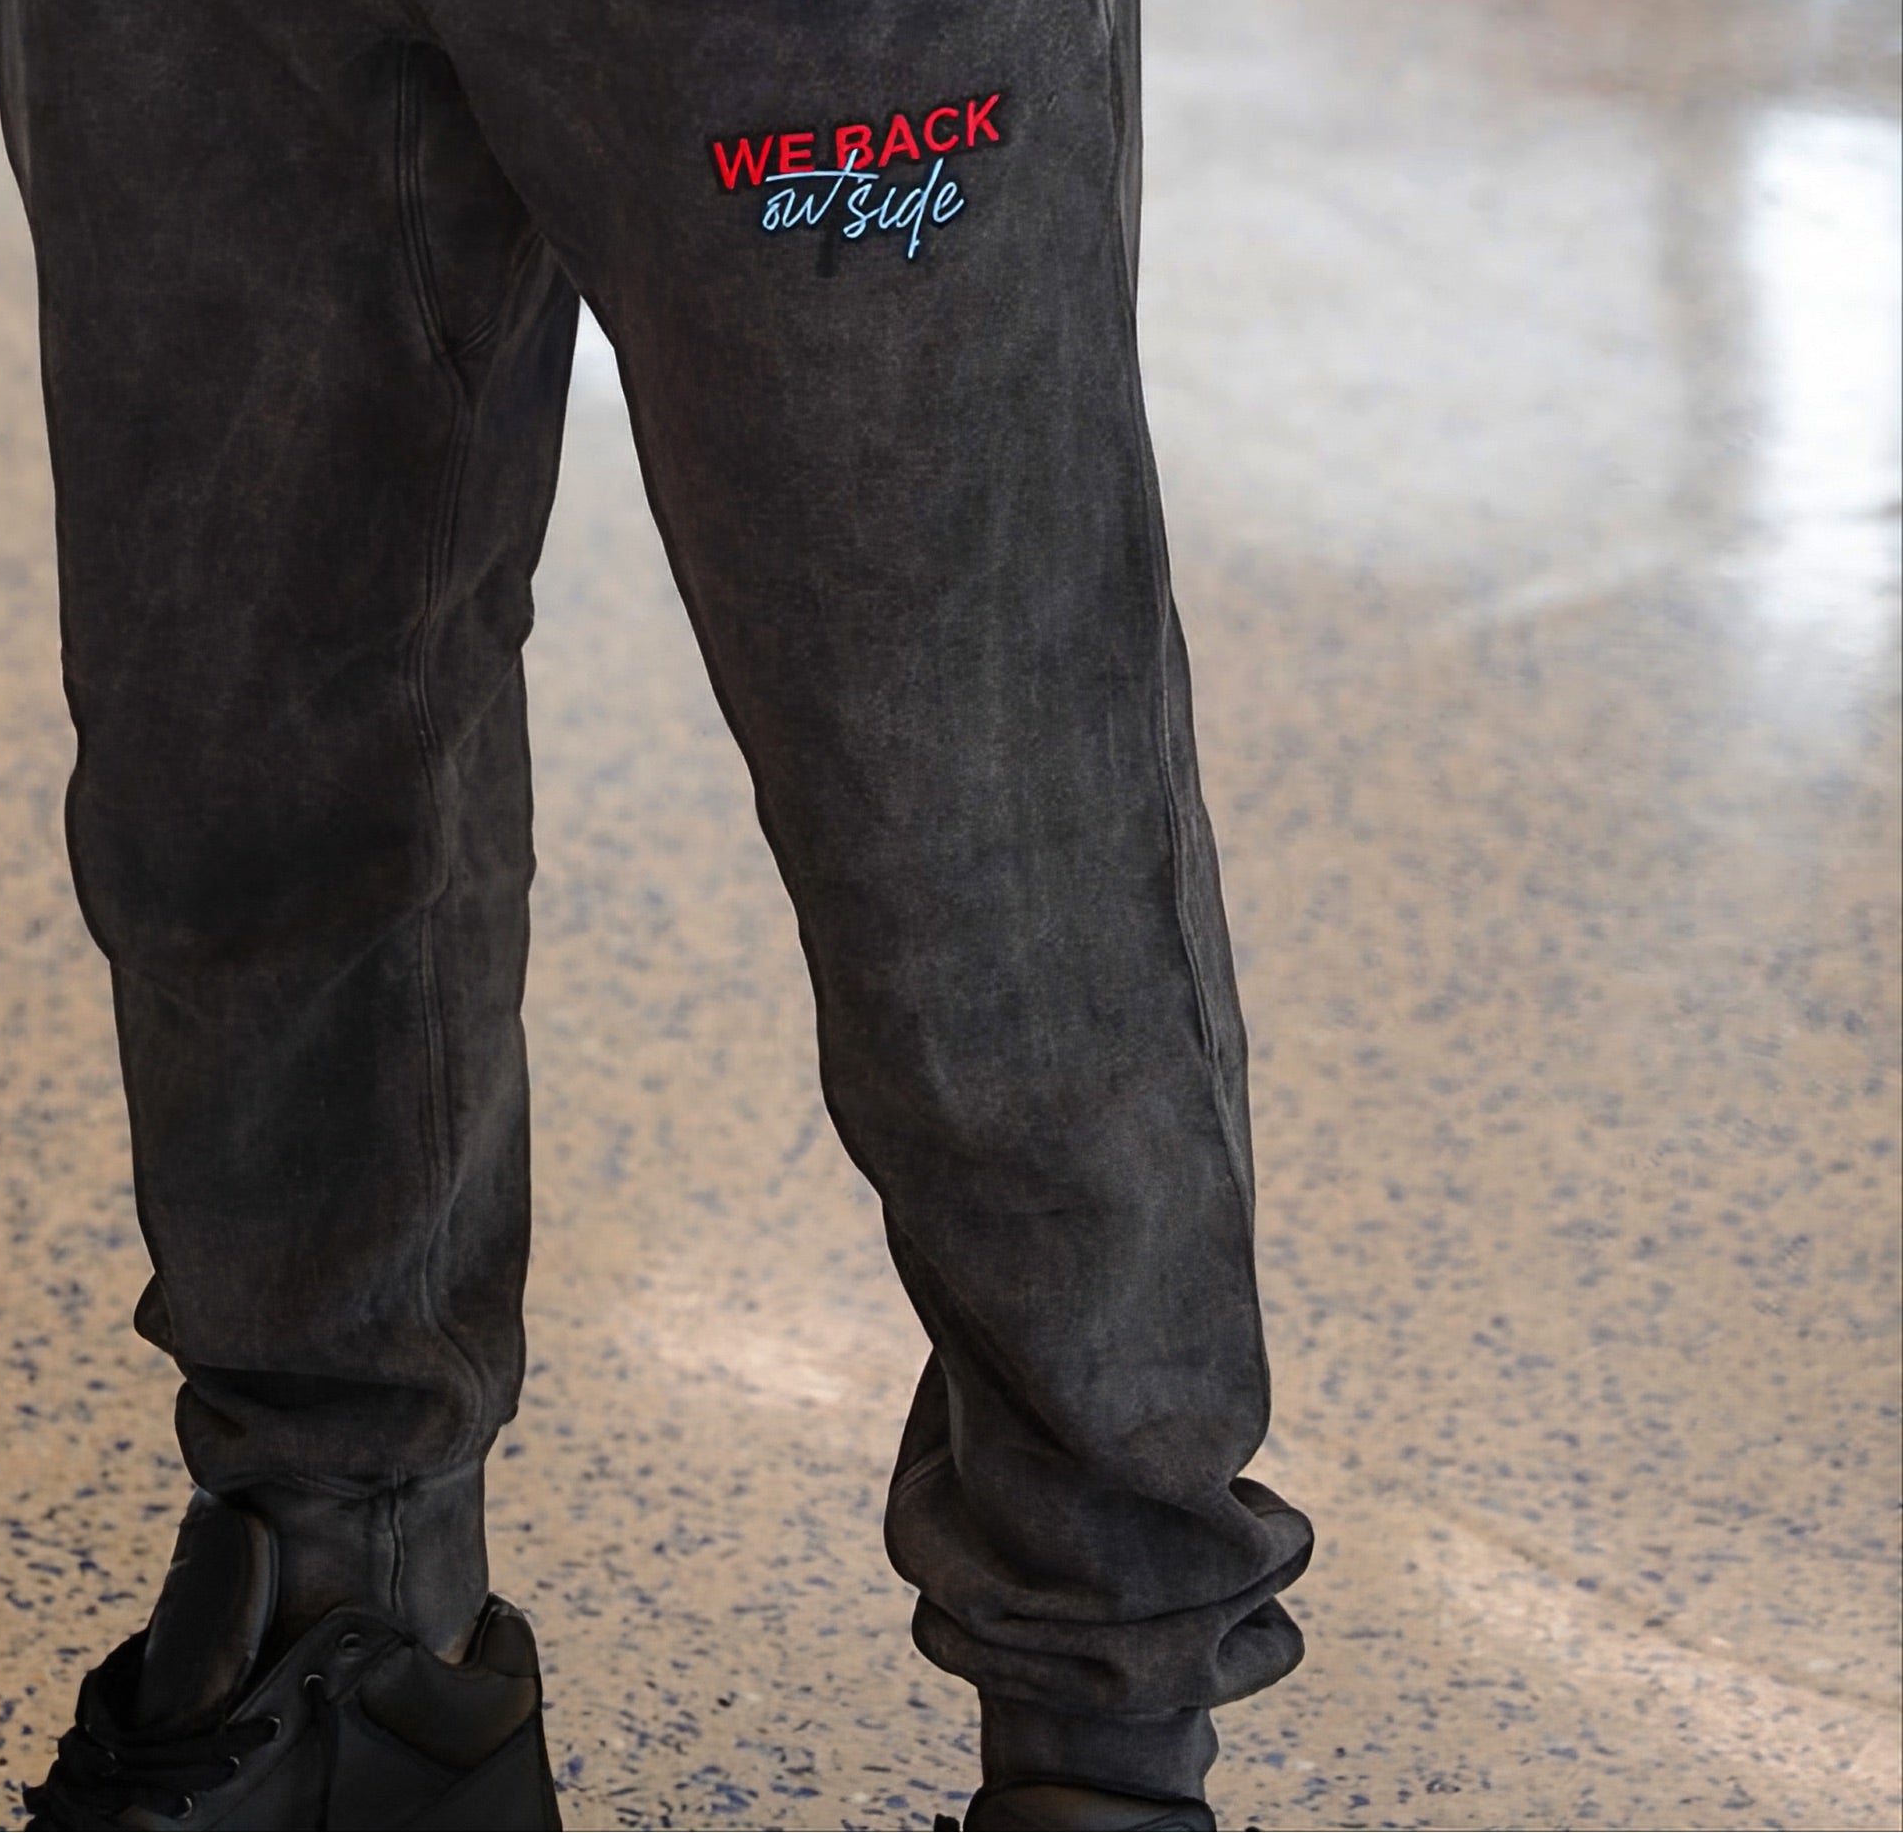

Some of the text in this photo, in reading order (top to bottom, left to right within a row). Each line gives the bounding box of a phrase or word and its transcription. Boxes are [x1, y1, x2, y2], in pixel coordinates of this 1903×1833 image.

[712, 94, 1000, 190] WE BACK
[762, 148, 965, 259] outside
